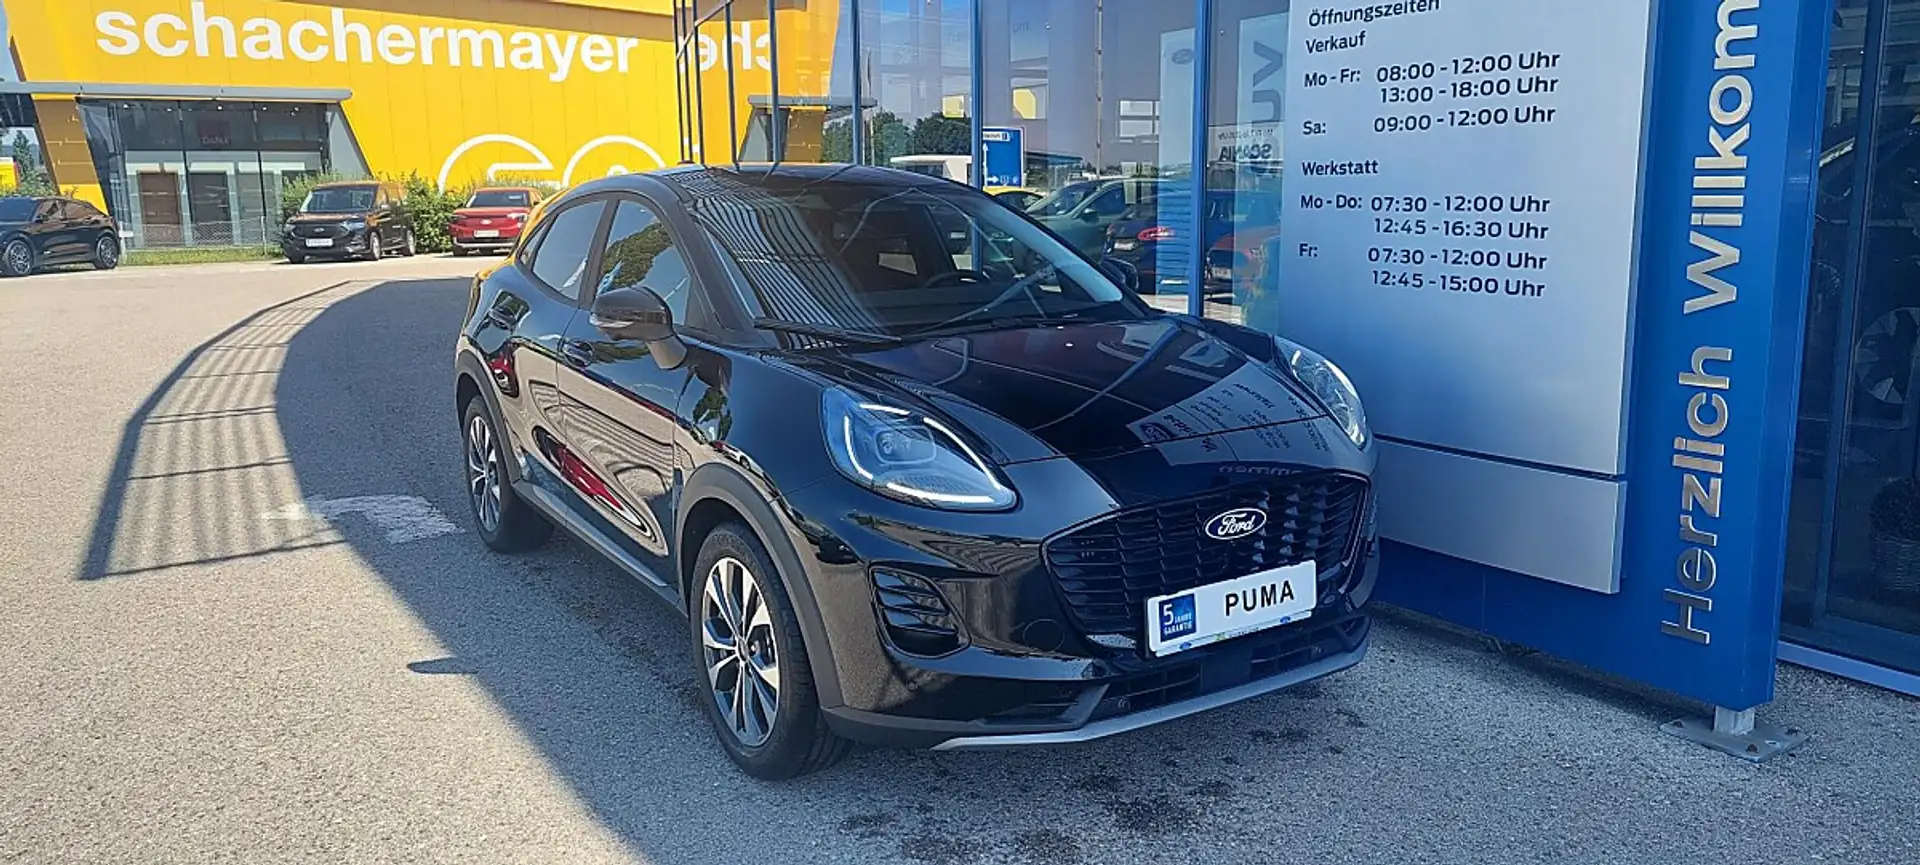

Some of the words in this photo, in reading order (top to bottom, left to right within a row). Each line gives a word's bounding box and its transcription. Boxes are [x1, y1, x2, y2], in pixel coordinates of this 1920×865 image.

[1309, 0, 1439, 26] Öffnungszeiten
[95, 1, 638, 82] schachermayer
[1305, 31, 1366, 53] Verkauf
[1304, 73, 1327, 87] Mo
[1340, 69, 1360, 83] Fr:
[1376, 63, 1434, 82] 08:00
[1452, 55, 1511, 74] 12:00
[1518, 52, 1560, 69] Uhr
[1380, 87, 1433, 103] 13:00
[1450, 79, 1510, 98] 18:00
[1516, 76, 1558, 93] Uhr
[1302, 121, 1326, 135] Sa:
[1374, 115, 1431, 132] 09:00
[1448, 109, 1508, 126] 12:00
[1514, 106, 1555, 123] Uhr
[1301, 160, 1378, 176] Werkstatt
[1300, 195, 1323, 208] Mo
[1335, 194, 1362, 208] Do:
[1371, 197, 1426, 212] 07:30
[1444, 196, 1503, 212] 12:00
[1509, 196, 1550, 212] Uhr
[1374, 218, 1426, 234] 12:45
[1443, 221, 1501, 237] 16:30
[1508, 222, 1548, 239] Uhr
[1299, 243, 1317, 257] Fr:
[1367, 248, 1424, 264] 07:30
[1441, 249, 1500, 266] 12:00
[1506, 253, 1547, 269] Uhr
[1372, 270, 1423, 288] 12:45
[1439, 275, 1498, 293] 15:00
[1504, 279, 1545, 296] Uhr
[1661, 346, 1732, 644] Herzlich
[1217, 512, 1256, 536] Ford
[1225, 580, 1295, 617] PUMA
[1163, 604, 1175, 626] 5
